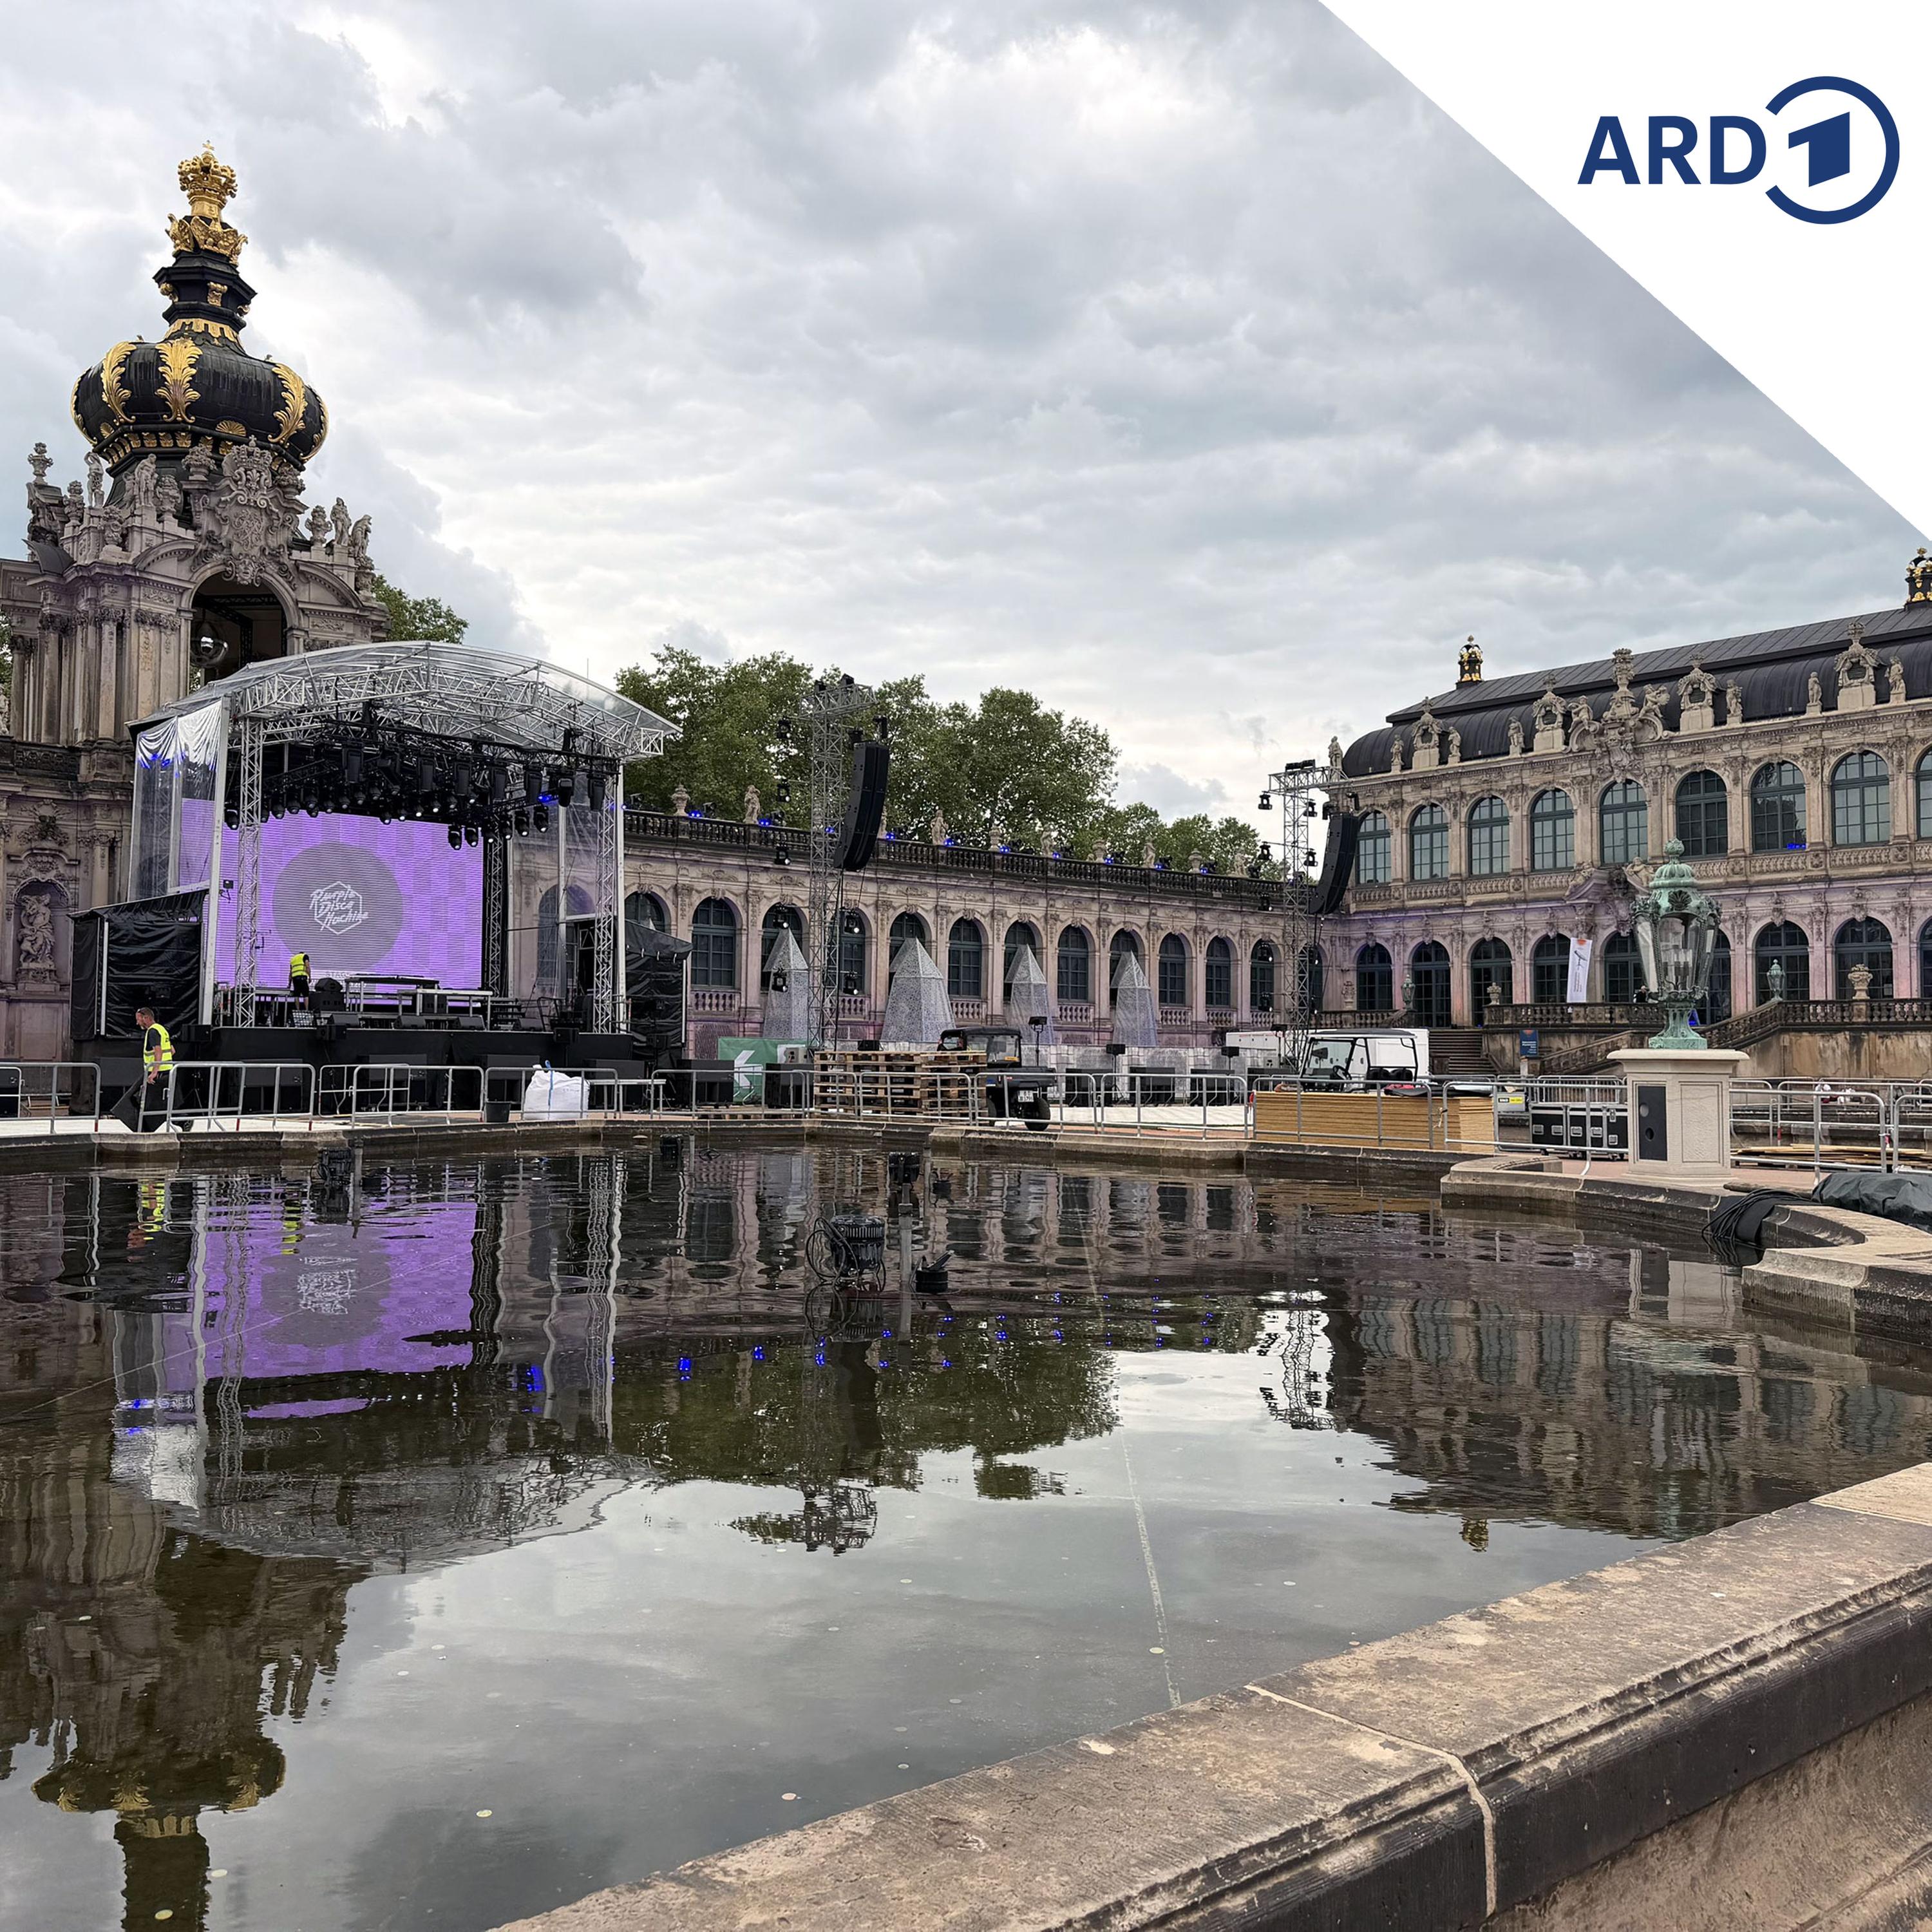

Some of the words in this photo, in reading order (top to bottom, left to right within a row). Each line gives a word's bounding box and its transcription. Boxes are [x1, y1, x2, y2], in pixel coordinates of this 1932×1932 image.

[309, 884, 356, 909] Purple
[316, 901, 355, 918] Disco
[320, 909, 369, 931] Machine
